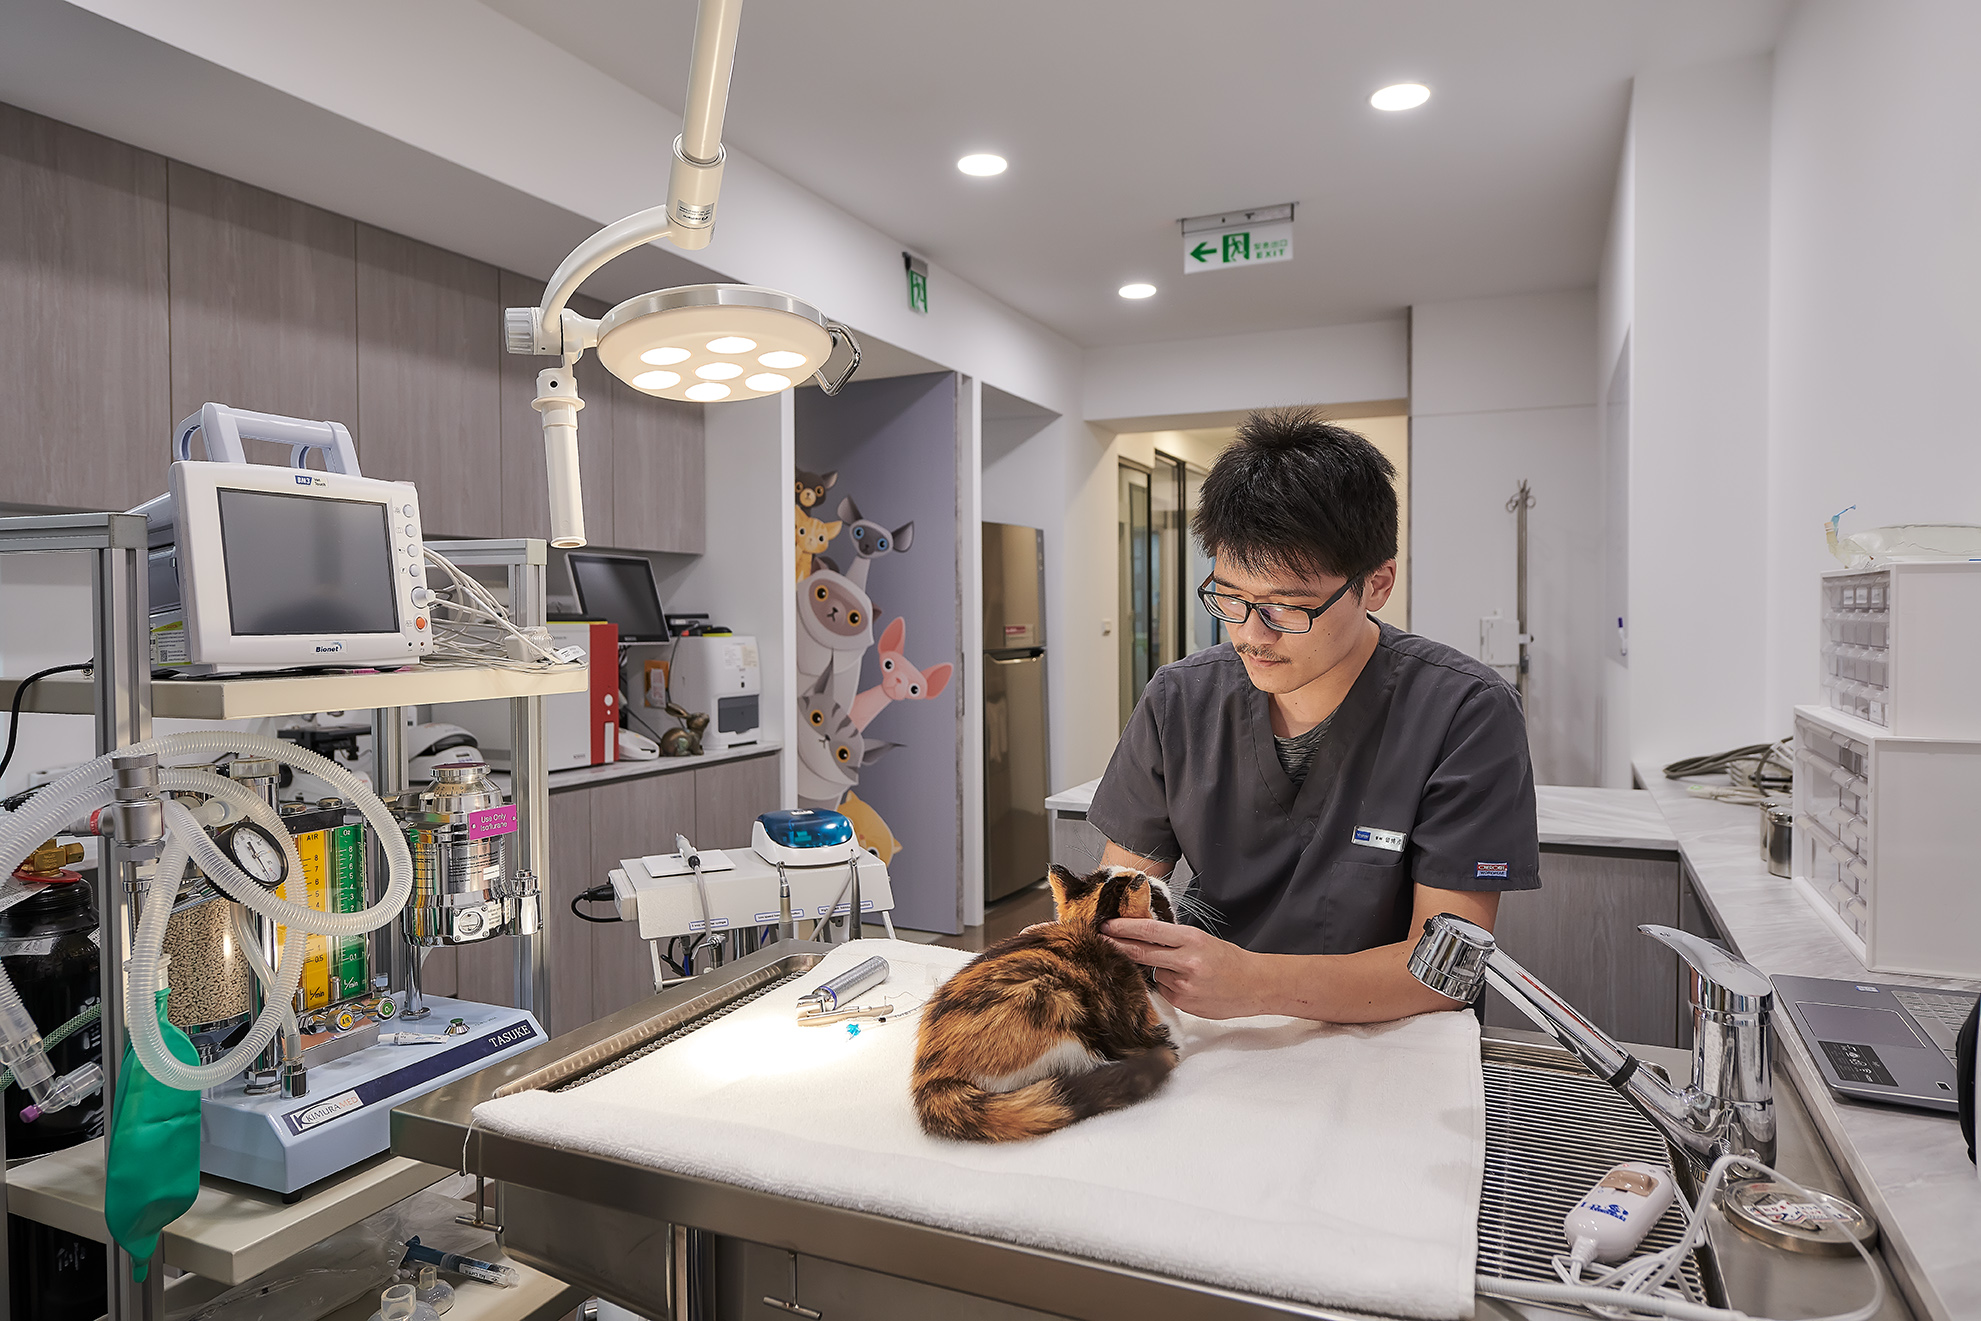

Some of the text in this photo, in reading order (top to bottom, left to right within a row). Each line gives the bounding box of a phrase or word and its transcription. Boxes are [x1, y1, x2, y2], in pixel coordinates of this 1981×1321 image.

[1256, 248, 1285, 259] EXIT
[315, 645, 339, 653] Bionet
[480, 813, 507, 824] Use Only
[306, 833, 319, 842] AIR
[348, 845, 354, 853] 8
[314, 854, 319, 862] 8
[314, 865, 319, 873] 7
[348, 863, 354, 871] 6
[314, 878, 320, 886] 6
[315, 890, 320, 898] 5
[350, 904, 355, 912] 2
[314, 954, 324, 963] 0.5
[349, 953, 357, 961] 0.1
[488, 1024, 531, 1048] TASUKE
